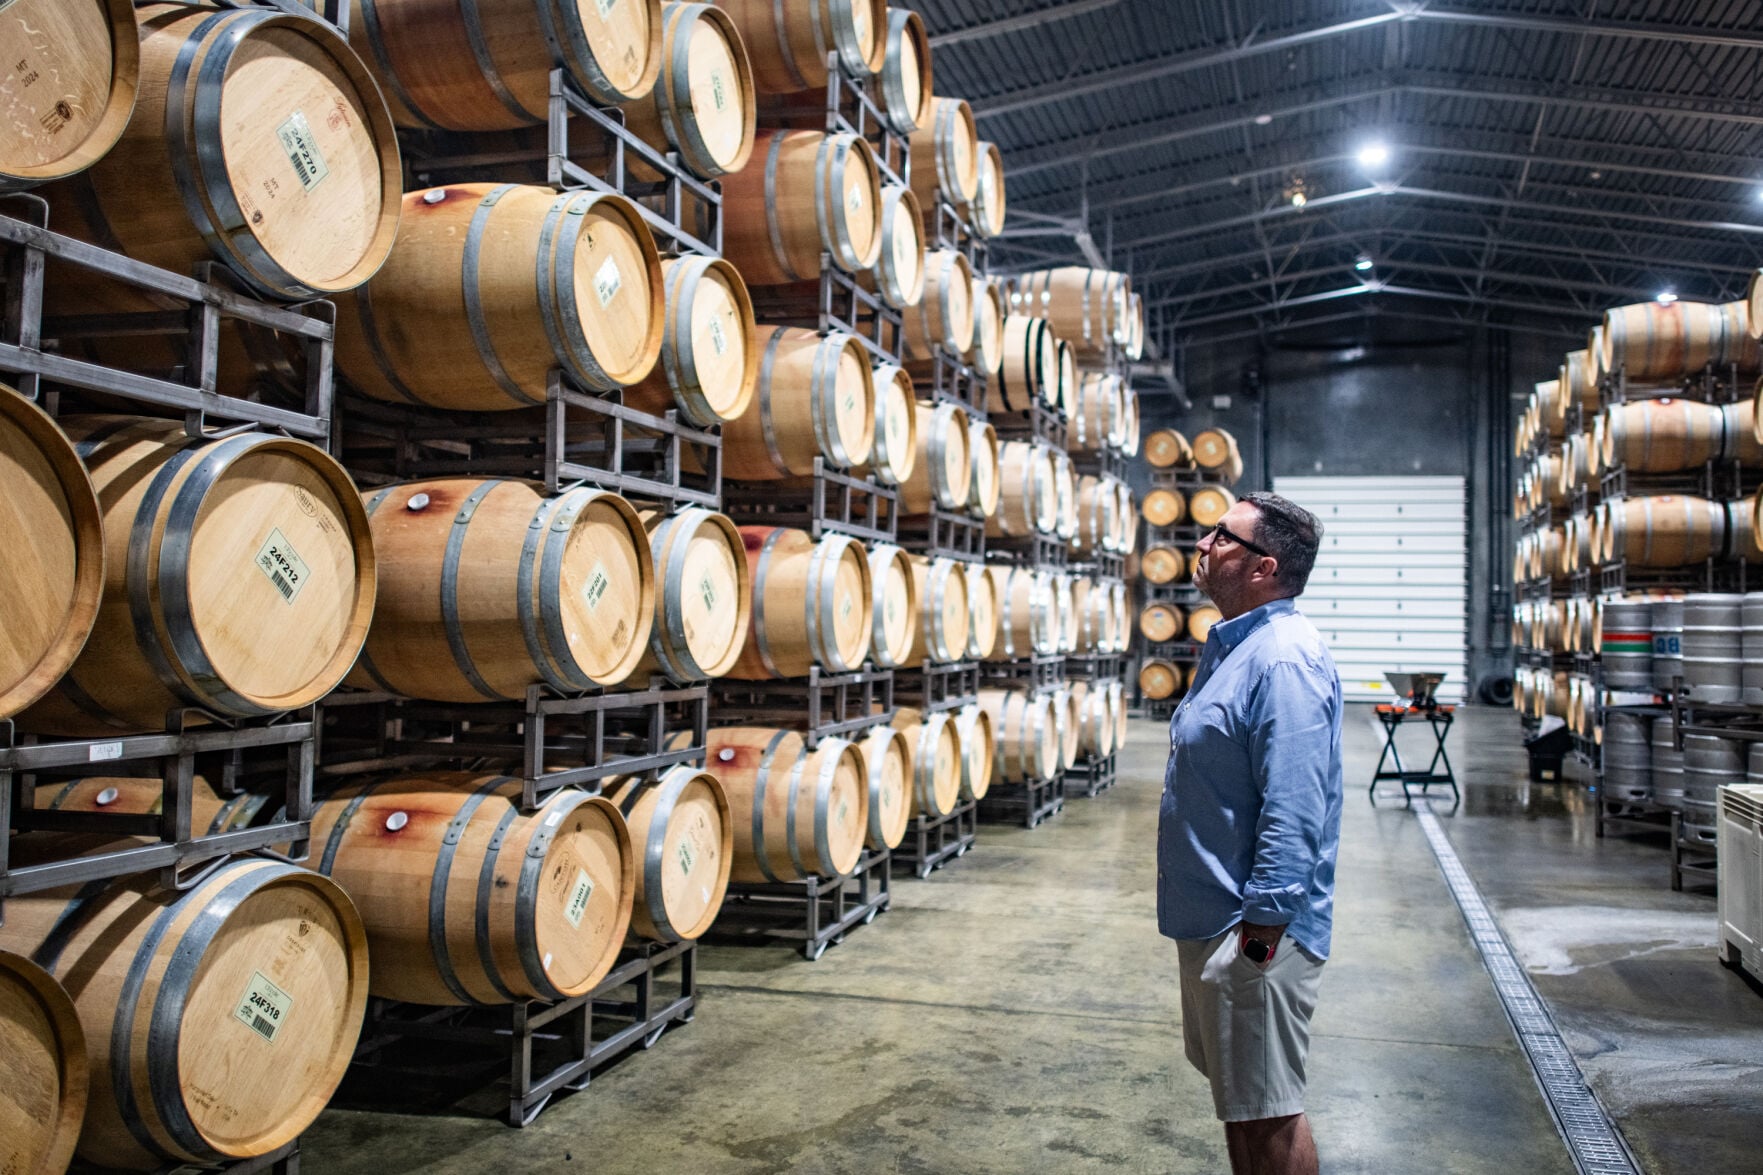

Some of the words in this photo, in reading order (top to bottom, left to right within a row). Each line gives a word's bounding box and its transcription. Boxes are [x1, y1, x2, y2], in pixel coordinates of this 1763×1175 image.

[15, 59, 28, 73] MT
[21, 70, 39, 87] 2024
[291, 128, 317, 174] 24F270
[295, 486, 316, 513] Saury
[269, 546, 299, 584] 24F212
[249, 991, 280, 1020] 24F318
